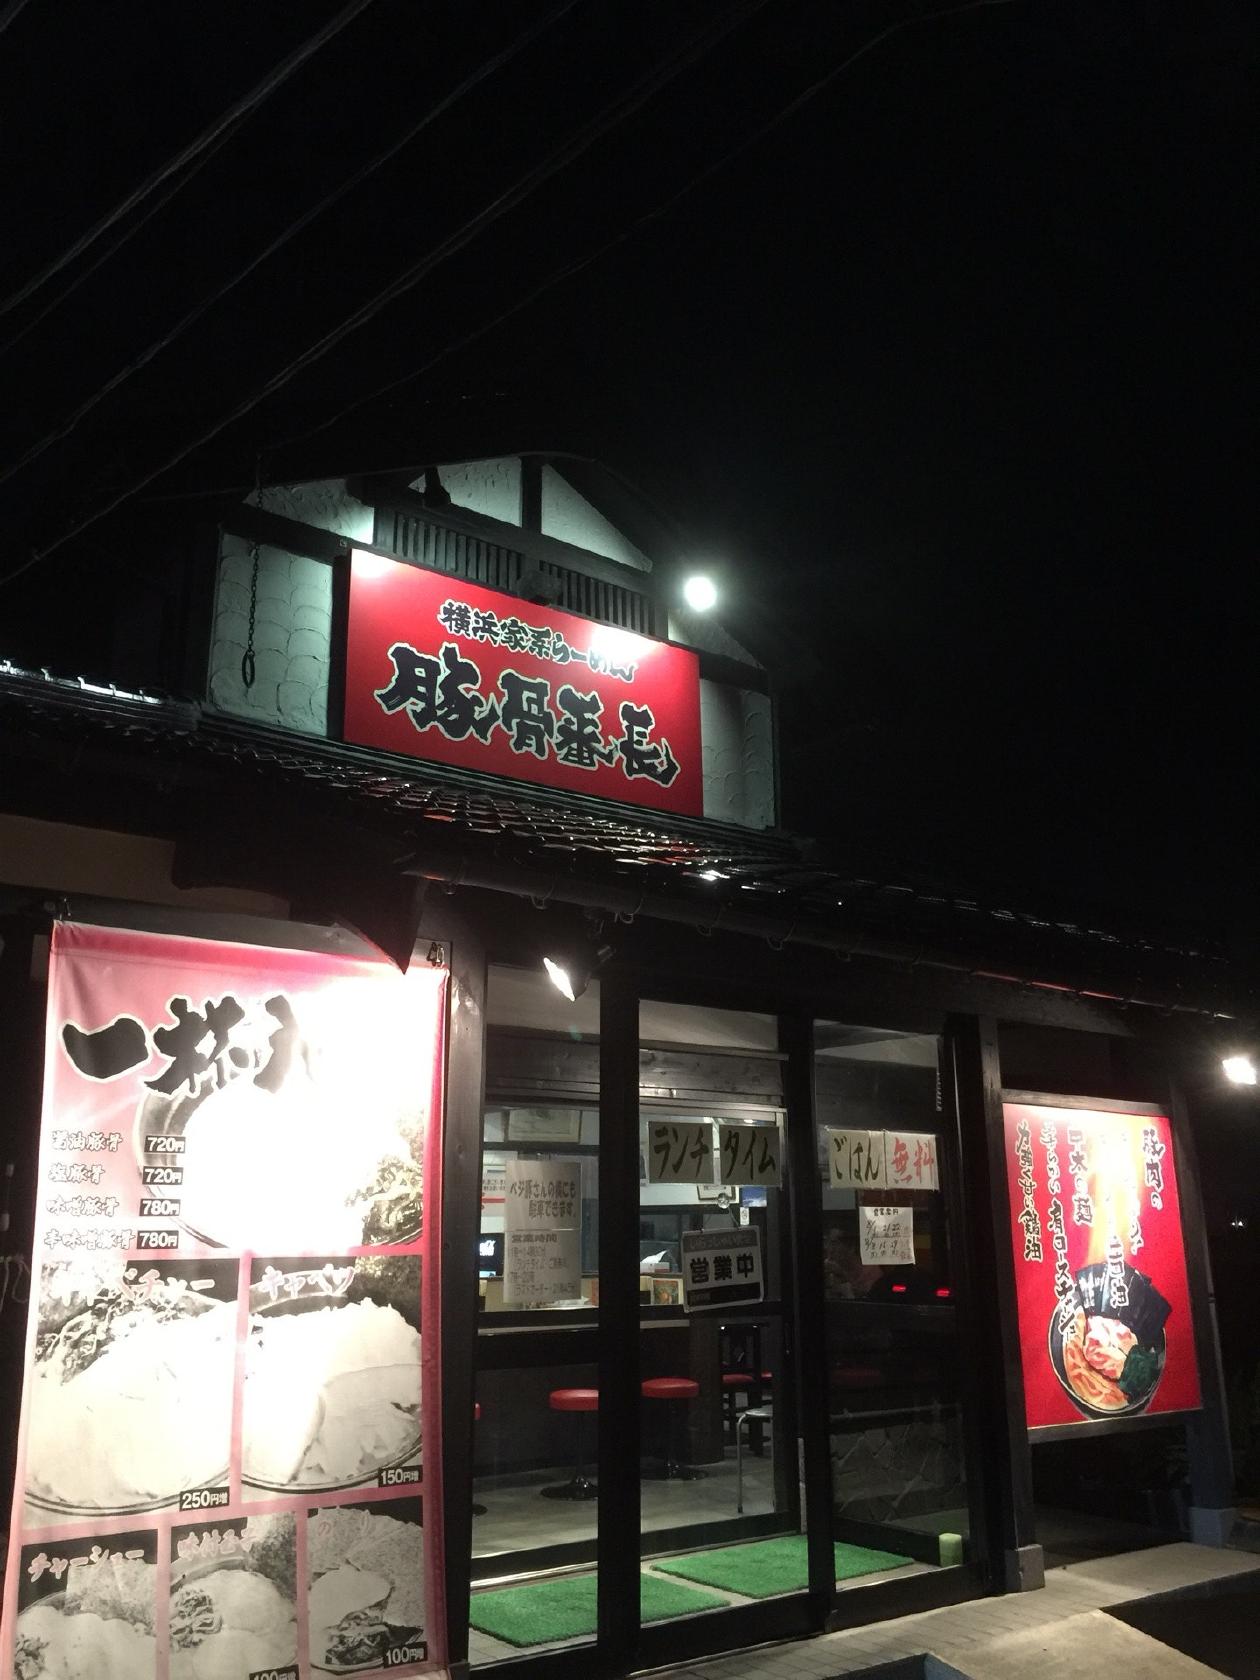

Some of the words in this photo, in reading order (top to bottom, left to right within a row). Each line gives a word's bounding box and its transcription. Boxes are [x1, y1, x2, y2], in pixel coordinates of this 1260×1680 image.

[374, 641, 682, 787] 豚骨番長
[147, 1137, 185, 1152] 720円
[653, 1126, 709, 1178] ランチ
[722, 1129, 776, 1180] タイム
[834, 1136, 880, 1183] ごはん
[892, 1137, 935, 1184] 無料
[144, 1168, 183, 1184] 720円
[142, 1200, 180, 1215] 780円
[139, 1232, 178, 1248] 780円
[690, 1253, 754, 1284] 営業中
[259, 1263, 356, 1303] キャベツ
[380, 1470, 420, 1485] 150円増
[181, 1490, 228, 1510] 250円増
[28, 1545, 145, 1583] チャーシュー
[386, 1648, 425, 1665] 100円増
